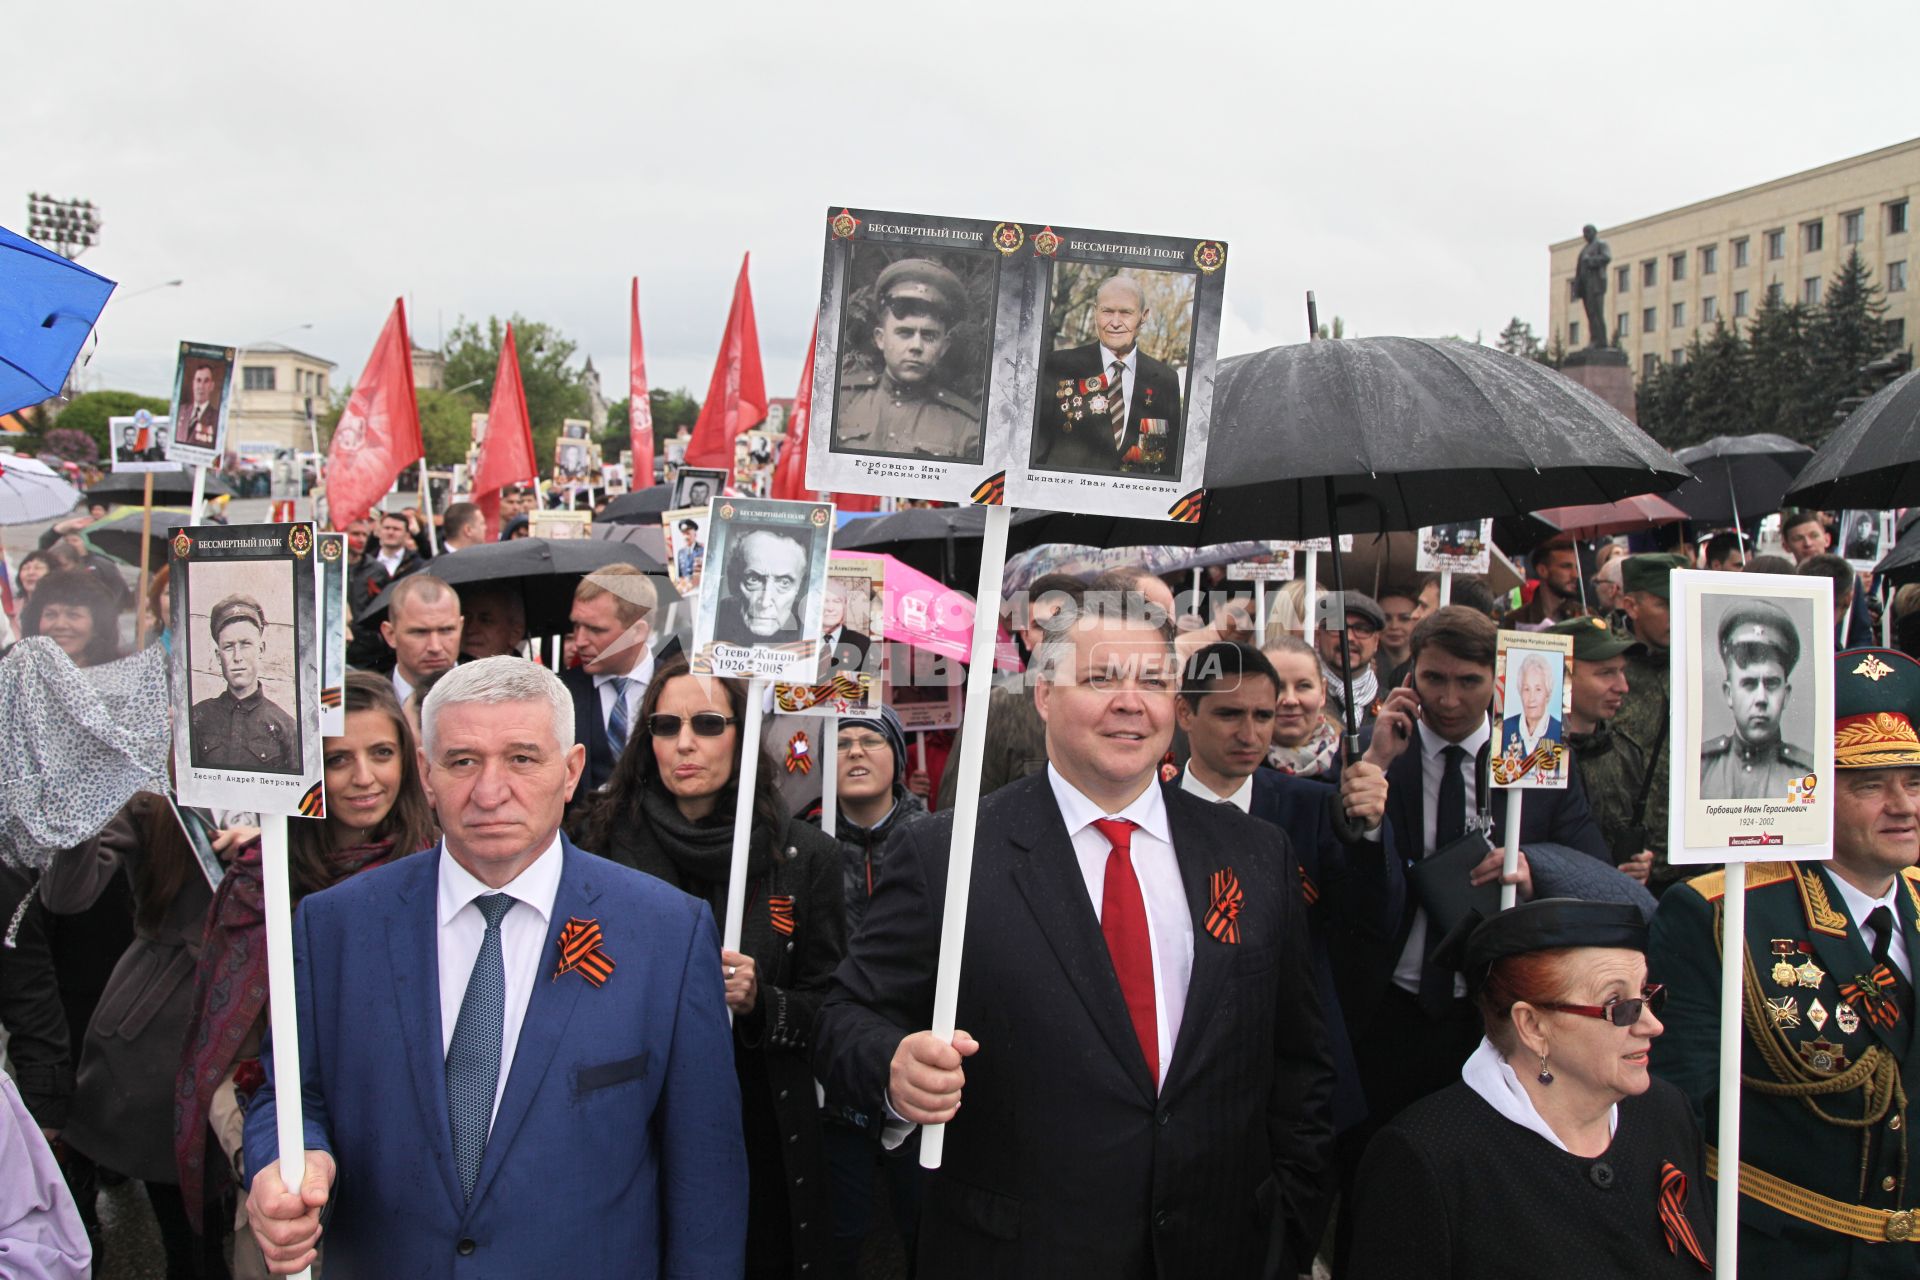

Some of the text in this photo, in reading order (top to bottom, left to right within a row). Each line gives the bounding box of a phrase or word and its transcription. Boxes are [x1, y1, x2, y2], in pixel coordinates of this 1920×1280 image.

[868, 223, 984, 241] БЕССМЕРТНЫЙ ПОЛК
[1070, 240, 1185, 260] БЕССМЕРТНЫЙ ПОЛК
[855, 459, 948, 474] Горбовцов Иван
[867, 468, 940, 480] Герасимович
[1080, 479, 1106, 488] Иван
[1112, 482, 1178, 494] Алексеевич
[198, 536, 282, 549] БЕССМЕРТНЫЙ ПОЛК
[715, 645, 795, 661] Стево Жигон
[719, 659, 745, 671] 1926
[756, 662, 784, 675] 2005
[194, 772, 301, 787] Лесной Андрей Петрович
[1802, 774, 1817, 796] 9
[1706, 804, 1808, 815] Горбовцов Иван Герасимович
[1739, 818, 1755, 826] 1924
[1759, 817, 1775, 826] 2002
